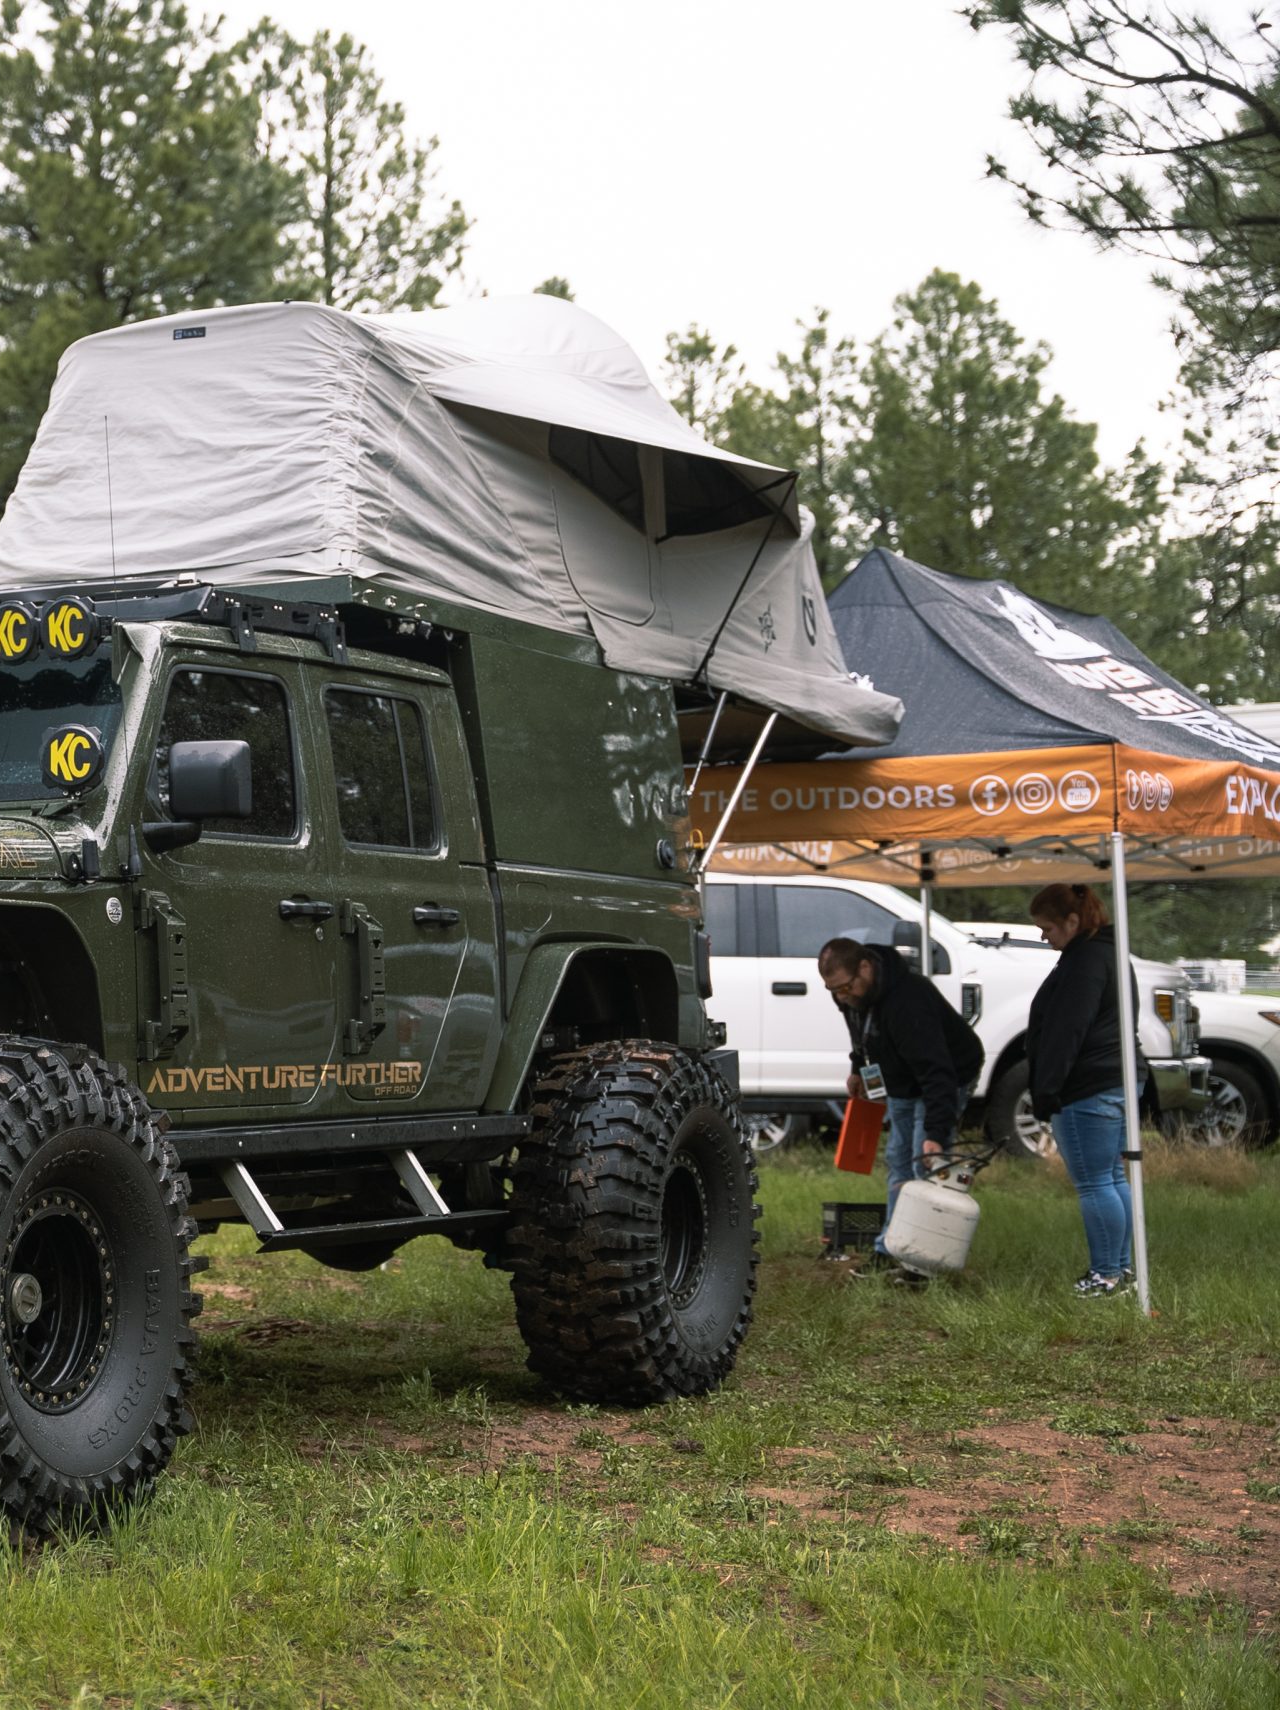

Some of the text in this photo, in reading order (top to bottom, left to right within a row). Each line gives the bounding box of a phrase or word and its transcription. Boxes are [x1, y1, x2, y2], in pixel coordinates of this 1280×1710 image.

[48, 605, 84, 652] KC
[50, 732, 91, 781] KC
[699, 784, 957, 812] THE OUTDOORS
[147, 1061, 422, 1094] ADVENTURE FURTHER
[374, 1084, 418, 1096] OFF ROAD
